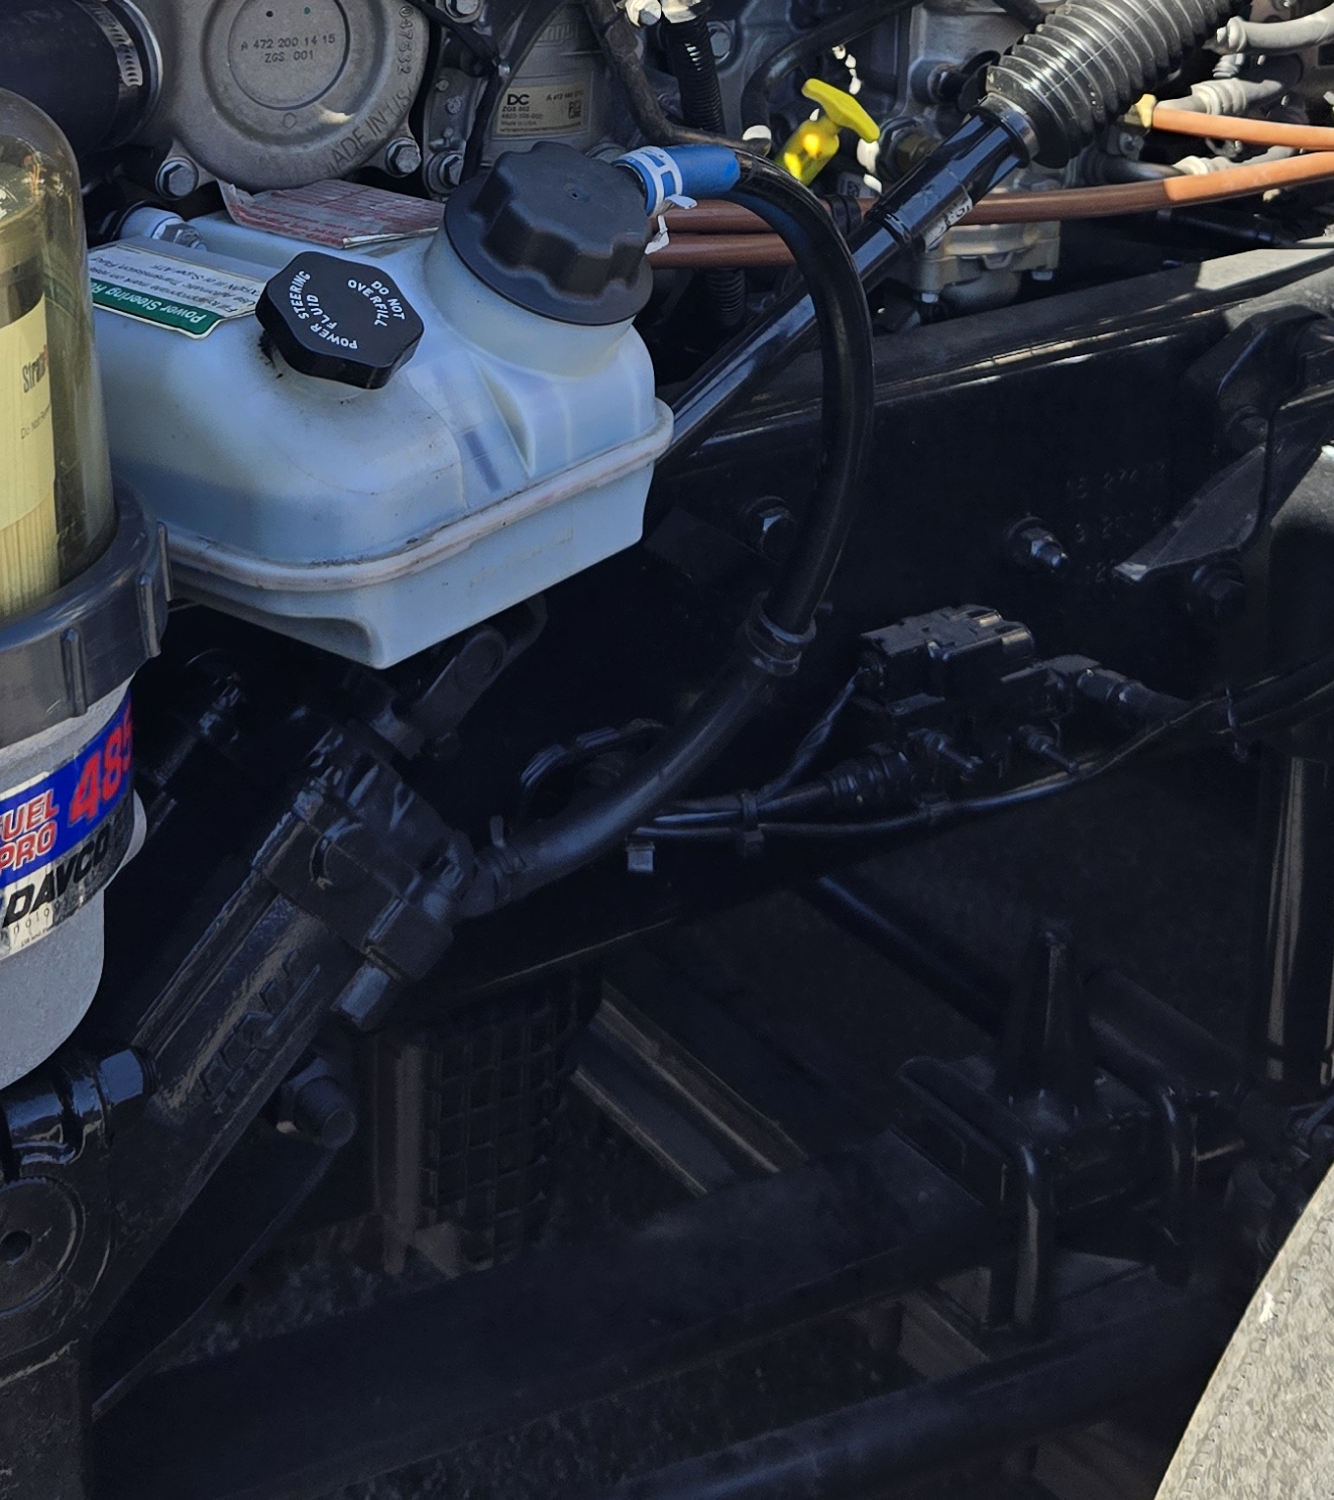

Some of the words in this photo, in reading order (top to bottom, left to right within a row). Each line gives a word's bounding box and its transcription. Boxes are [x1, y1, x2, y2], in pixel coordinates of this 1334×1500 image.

[241, 41, 248, 50] A
[253, 38, 274, 49] 472
[278, 37, 299, 48] 200
[304, 35, 318, 46] 14
[323, 33, 336, 44] 15
[264, 52, 285, 63] ZGS
[293, 50, 314, 61] 001
[507, 93, 530, 106] DC
[364, 111, 388, 138] IN
[106, 285, 161, 311] Steering
[289, 271, 311, 320] STEERING
[348, 279, 389, 327] OVERFILL
[371, 281, 389, 295] DO
[388, 298, 405, 320] NOT
[161, 303, 206, 323] Power
[307, 294, 338, 330] FLUID
[310, 323, 358, 350] POWER
[3, 827, 111, 928] DAVCO
